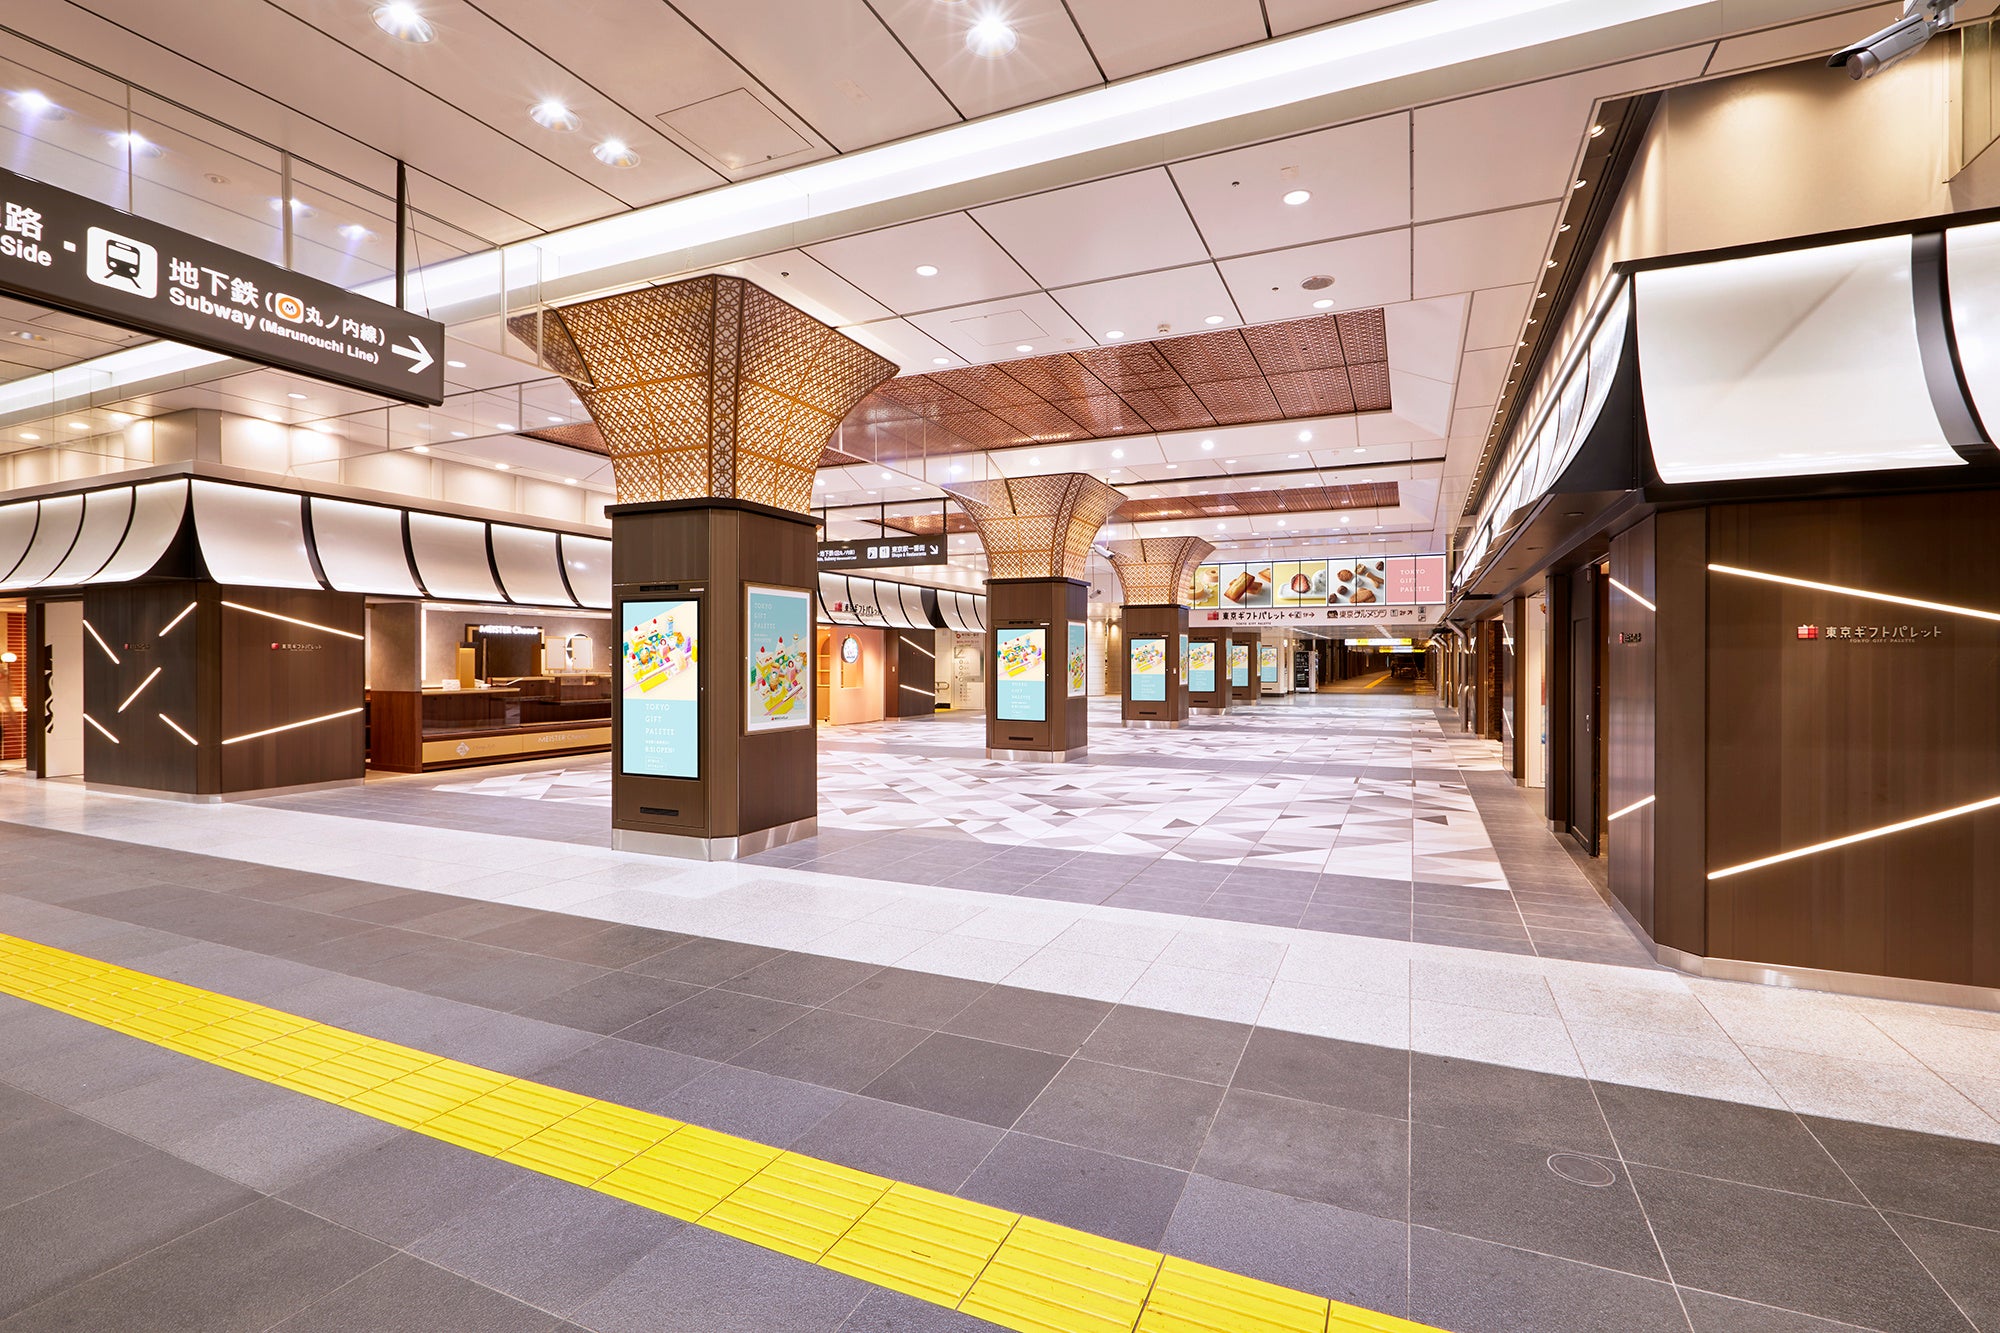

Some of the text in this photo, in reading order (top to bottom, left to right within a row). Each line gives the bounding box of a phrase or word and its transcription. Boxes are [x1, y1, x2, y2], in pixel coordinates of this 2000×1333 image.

[0, 235, 52, 267] Side
[169, 286, 380, 365] Subway (Marunouchi Line)
[1222, 611, 1285, 620] 東京ギフトパレット
[1825, 625, 1942, 639] 東京ギフトパレット
[645, 703, 670, 711] TOKYO
[645, 715, 662, 723] GIFT
